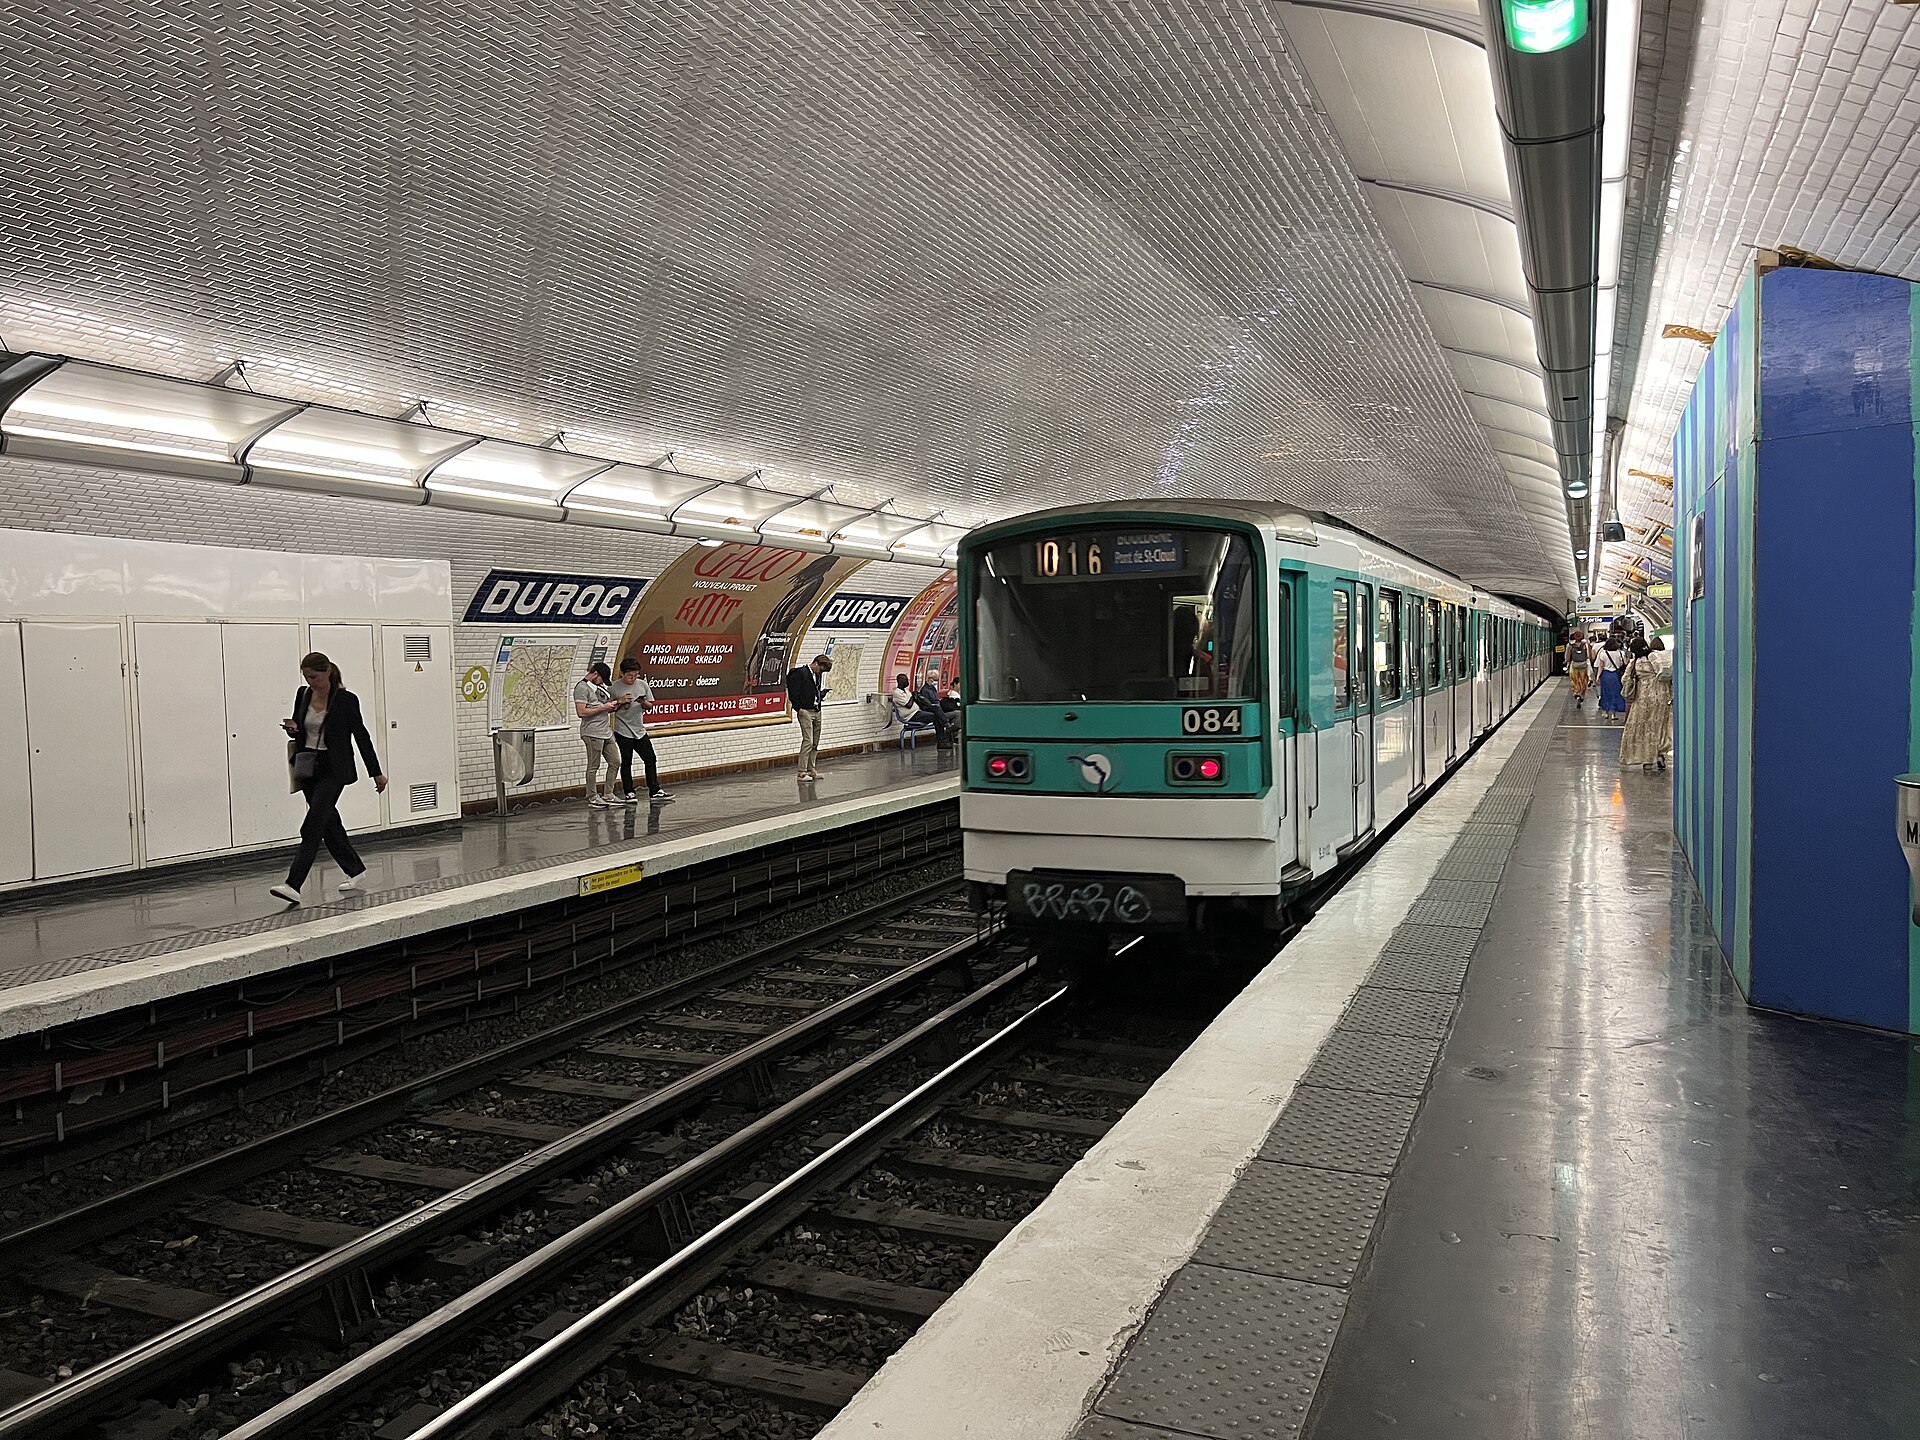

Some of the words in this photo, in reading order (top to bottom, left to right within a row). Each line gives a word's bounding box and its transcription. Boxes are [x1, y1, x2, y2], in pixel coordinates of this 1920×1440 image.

[694, 542, 807, 582] GAZO
[692, 580, 730, 591] NOUVEAU
[729, 583, 757, 592] PROJET
[480, 580, 630, 617] DUROC
[822, 599, 901, 624] DUROC
[643, 645, 671, 654] DAMSO
[675, 645, 700, 654] NINHO
[704, 645, 733, 654] TIAKOLA
[649, 656, 657, 665] M
[657, 655, 690, 665] HUNCHO
[694, 655, 723, 664] SKREAD
[649, 676, 675, 688] écouter
[676, 679, 688, 687] sur
[696, 675, 720, 687] deezer
[682, 703, 692, 713] LE
[1183, 709, 1241, 733] 084
